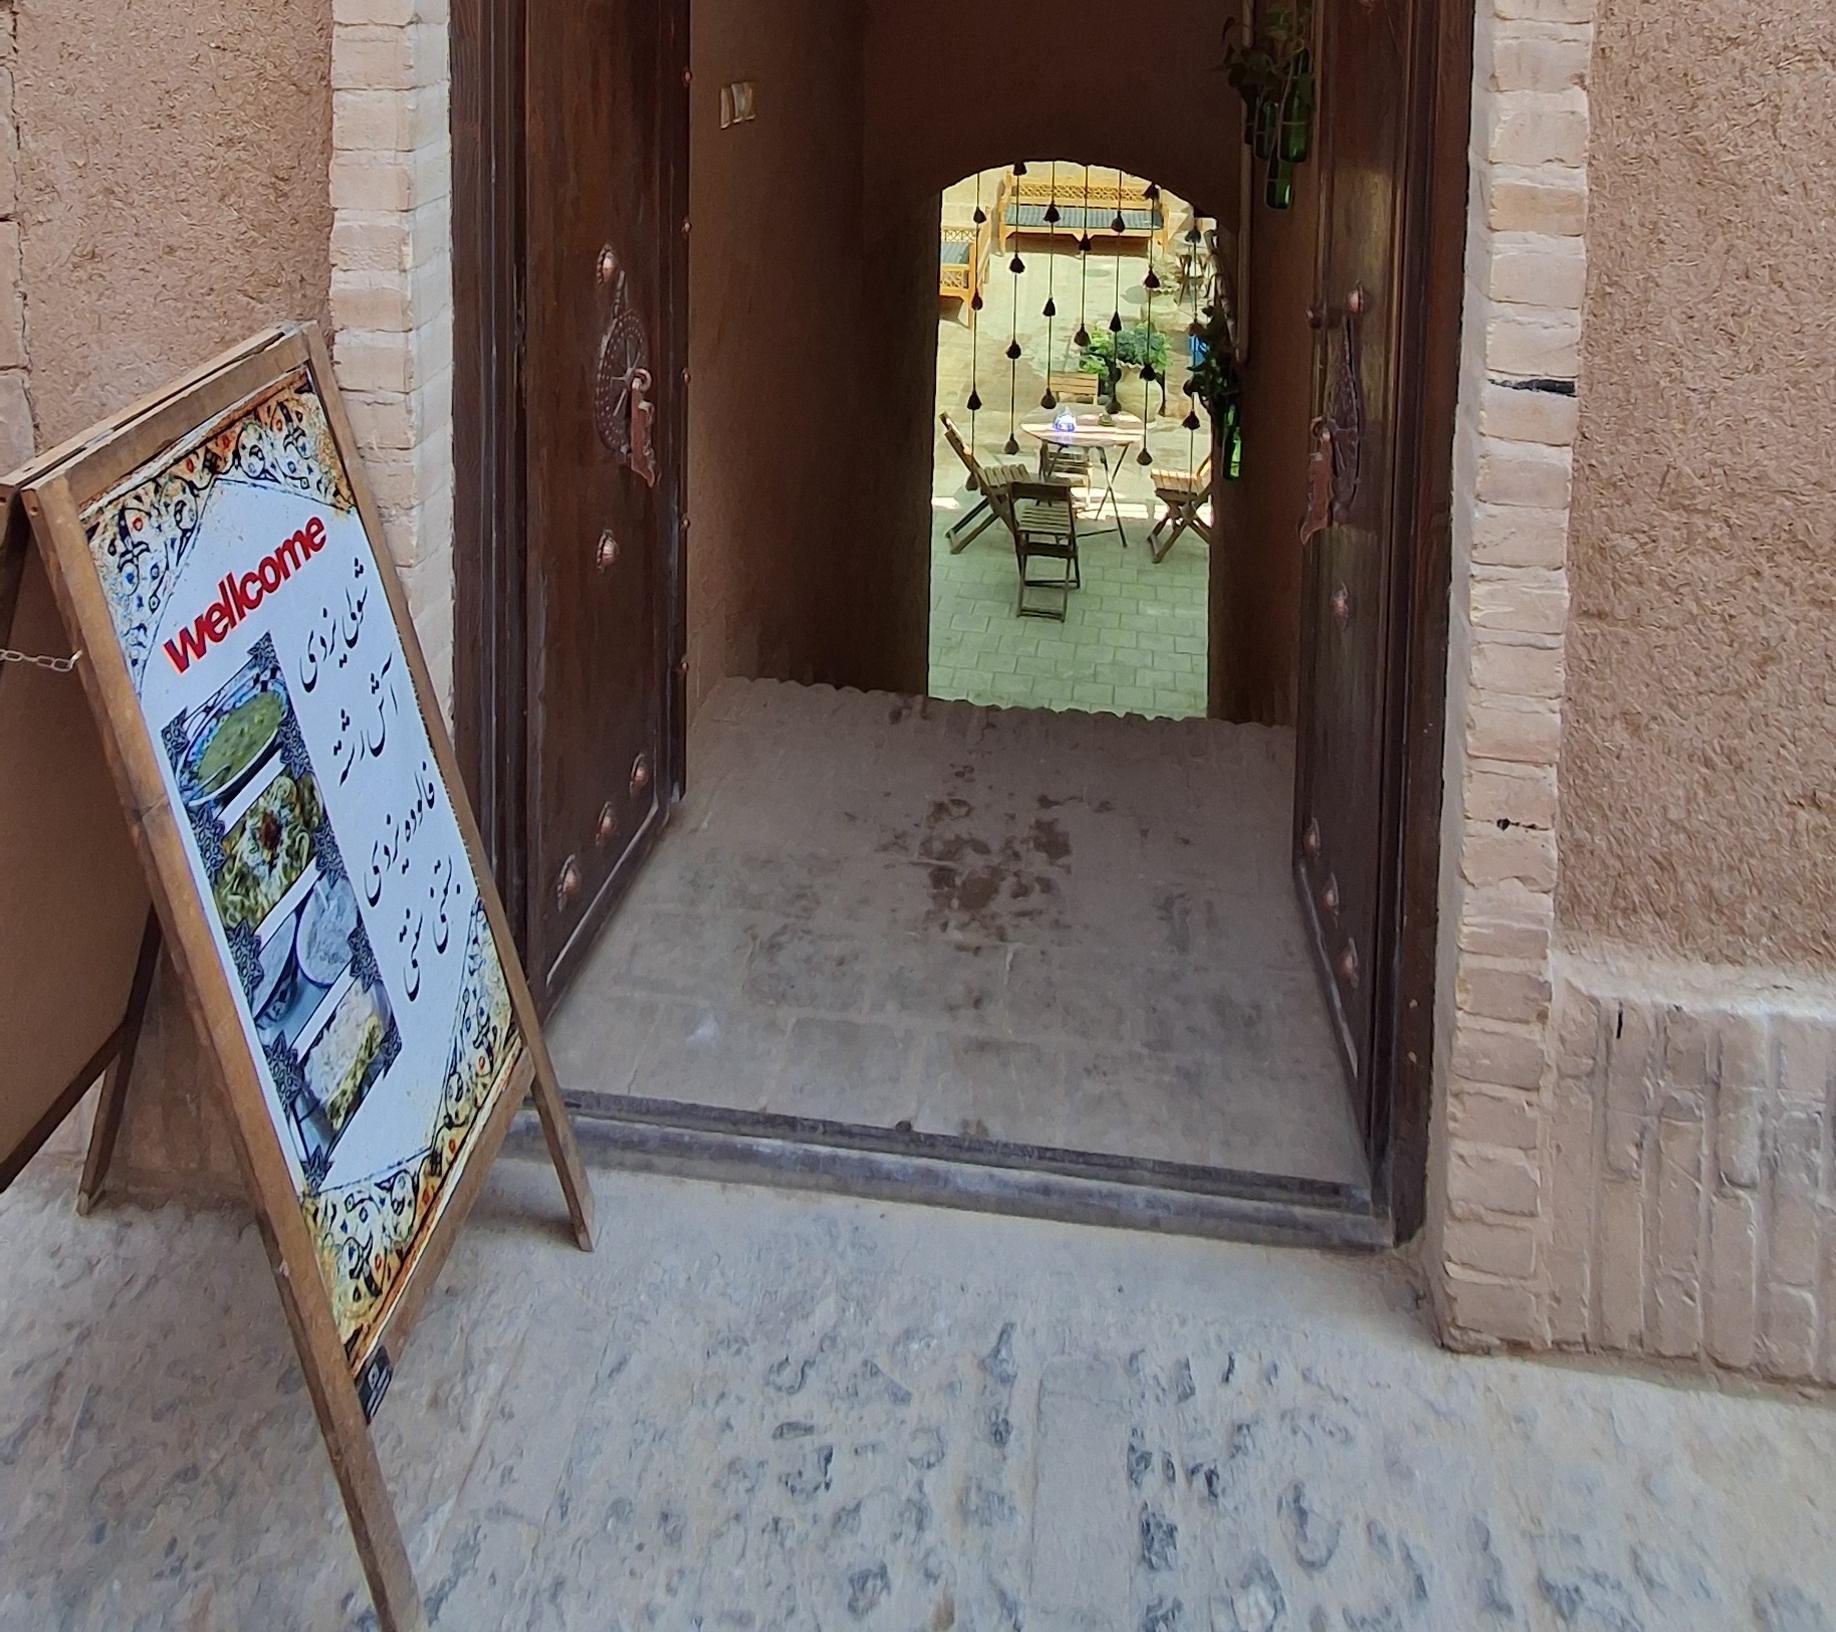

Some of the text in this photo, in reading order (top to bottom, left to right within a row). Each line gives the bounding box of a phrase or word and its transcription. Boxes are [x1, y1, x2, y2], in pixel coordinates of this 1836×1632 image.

[161, 515, 328, 676] wellcome
[299, 607, 349, 693] یزدی
[333, 651, 399, 787] آش رشته
[363, 761, 436, 908] فالوده یزدی
[398, 854, 462, 1003] بستنی سنتی
